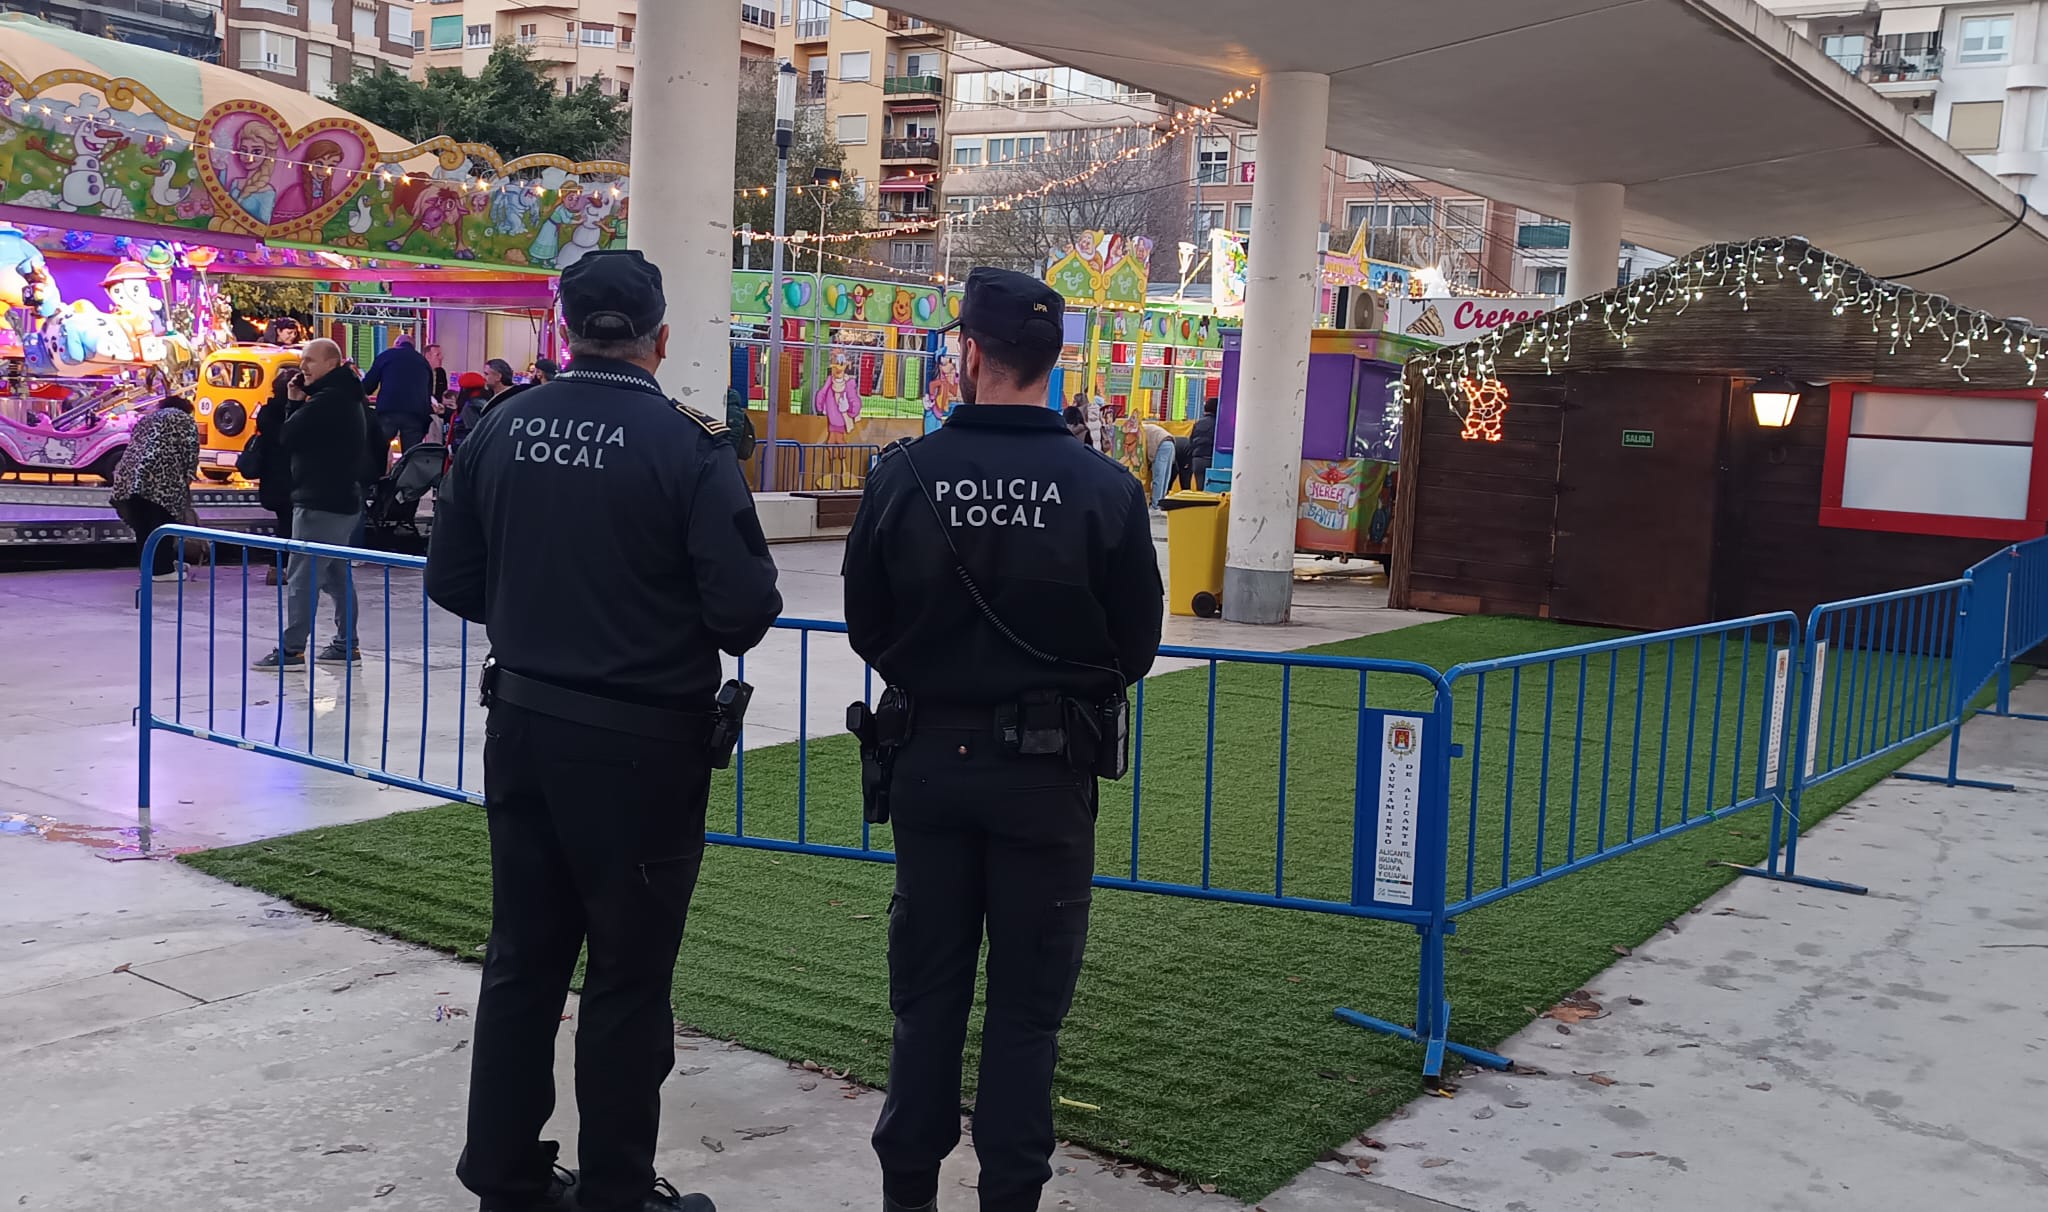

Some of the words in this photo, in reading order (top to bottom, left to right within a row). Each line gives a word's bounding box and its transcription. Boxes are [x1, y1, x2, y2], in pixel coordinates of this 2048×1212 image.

[509, 417, 625, 447] POLICIA
[1625, 434, 1651, 443] SALIDA
[515, 440, 604, 469] LOCAL
[935, 478, 1062, 505] POLICIA
[1311, 482, 1345, 501] NEREA
[950, 504, 1045, 528] LOCAL
[1405, 764, 1413, 778] DE
[1384, 762, 1396, 845] AYUNTAMIENTO
[1401, 787, 1411, 847] ALICANTE
